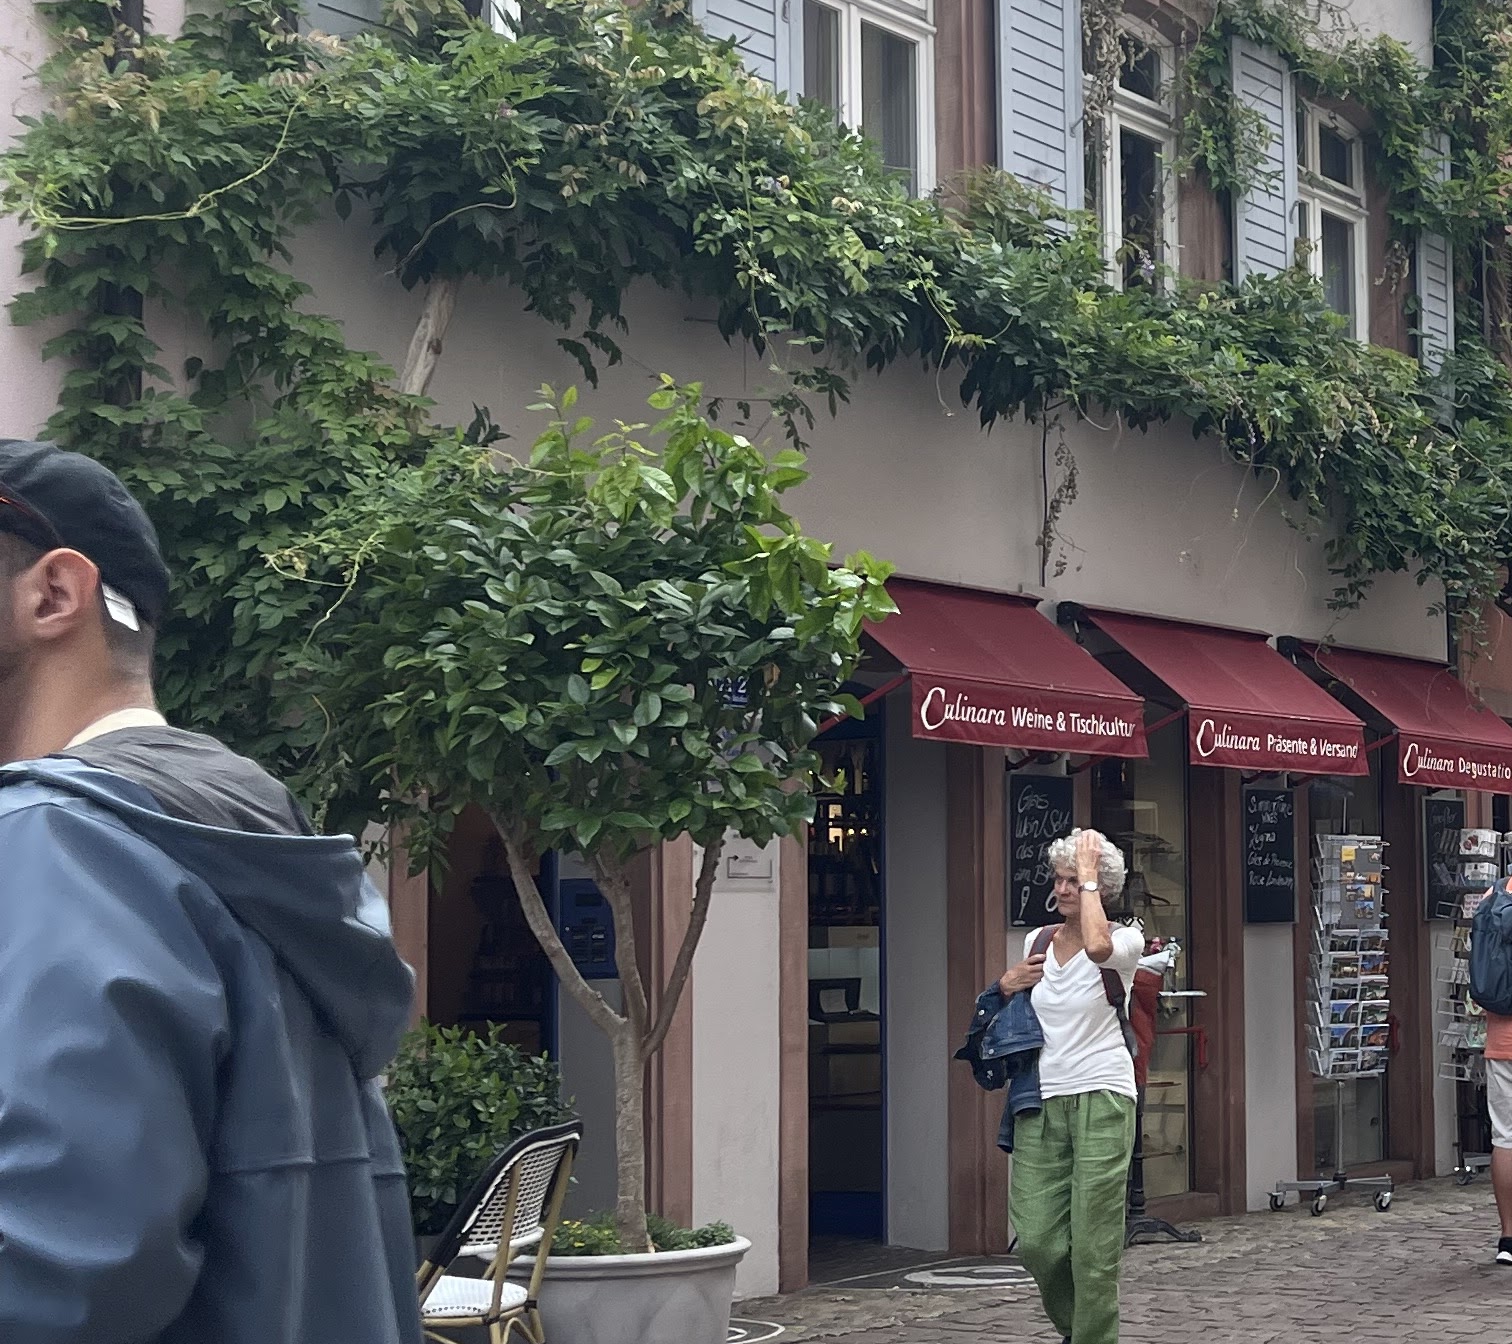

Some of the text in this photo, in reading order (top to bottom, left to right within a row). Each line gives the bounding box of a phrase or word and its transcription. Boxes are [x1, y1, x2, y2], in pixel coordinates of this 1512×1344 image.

[920, 686, 1136, 737] Culinara Weine & Tischkultur
[1196, 718, 1359, 759] Culinara Präsente & Versand
[1403, 742, 1455, 777] Culinara
